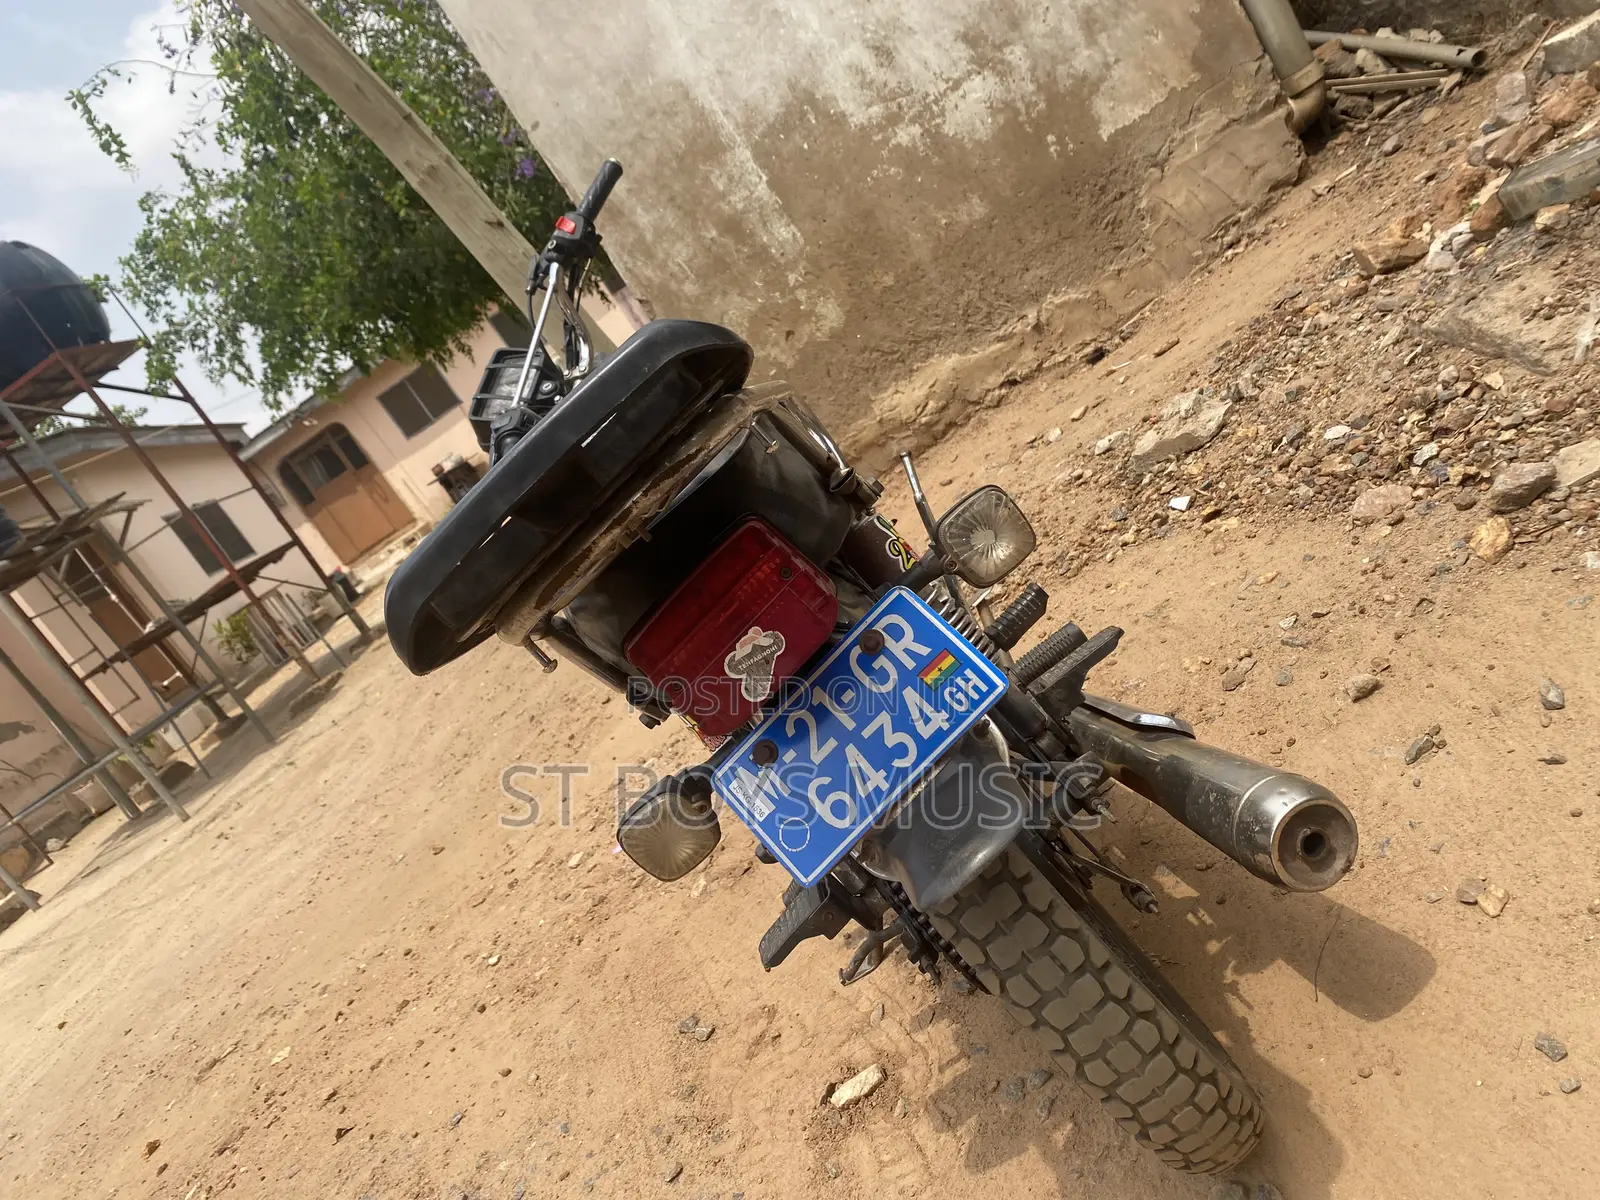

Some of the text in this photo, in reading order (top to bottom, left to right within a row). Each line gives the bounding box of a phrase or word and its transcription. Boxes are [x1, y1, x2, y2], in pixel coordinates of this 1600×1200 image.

[735, 614, 932, 810] M-21-GR
[803, 686, 950, 829] 6434
[943, 668, 988, 712] GH
